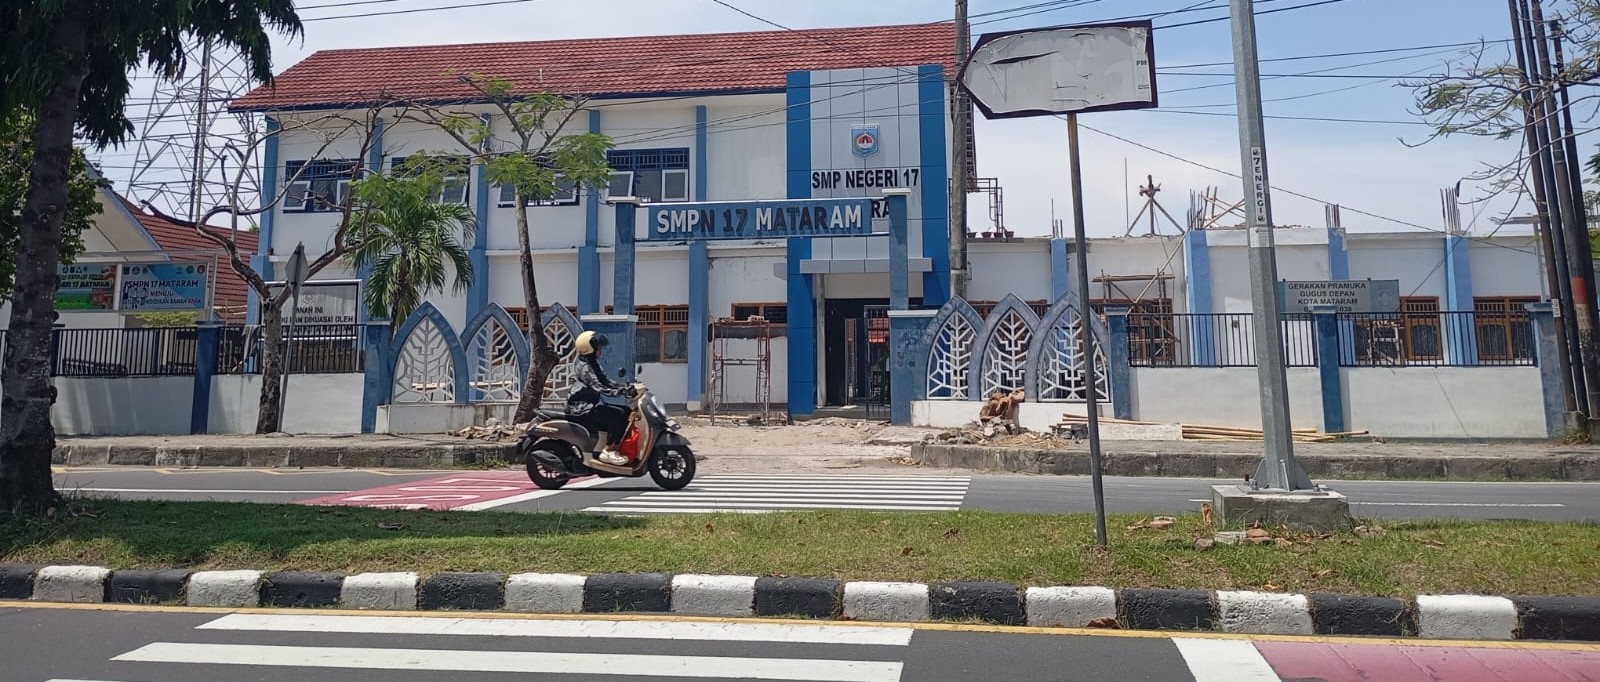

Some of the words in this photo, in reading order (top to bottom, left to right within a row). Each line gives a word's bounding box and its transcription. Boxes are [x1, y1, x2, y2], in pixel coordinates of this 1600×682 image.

[811, 171, 841, 189] SMP
[845, 169, 898, 188] NEGERI
[903, 168, 919, 187] 17
[656, 208, 715, 233] SMPN
[722, 208, 748, 232] 17
[755, 204, 863, 232] MATARAM
[128, 280, 149, 288] SMPN
[1288, 282, 1326, 290] GERAKAN
[1328, 281, 1366, 289] PRAMUKA
